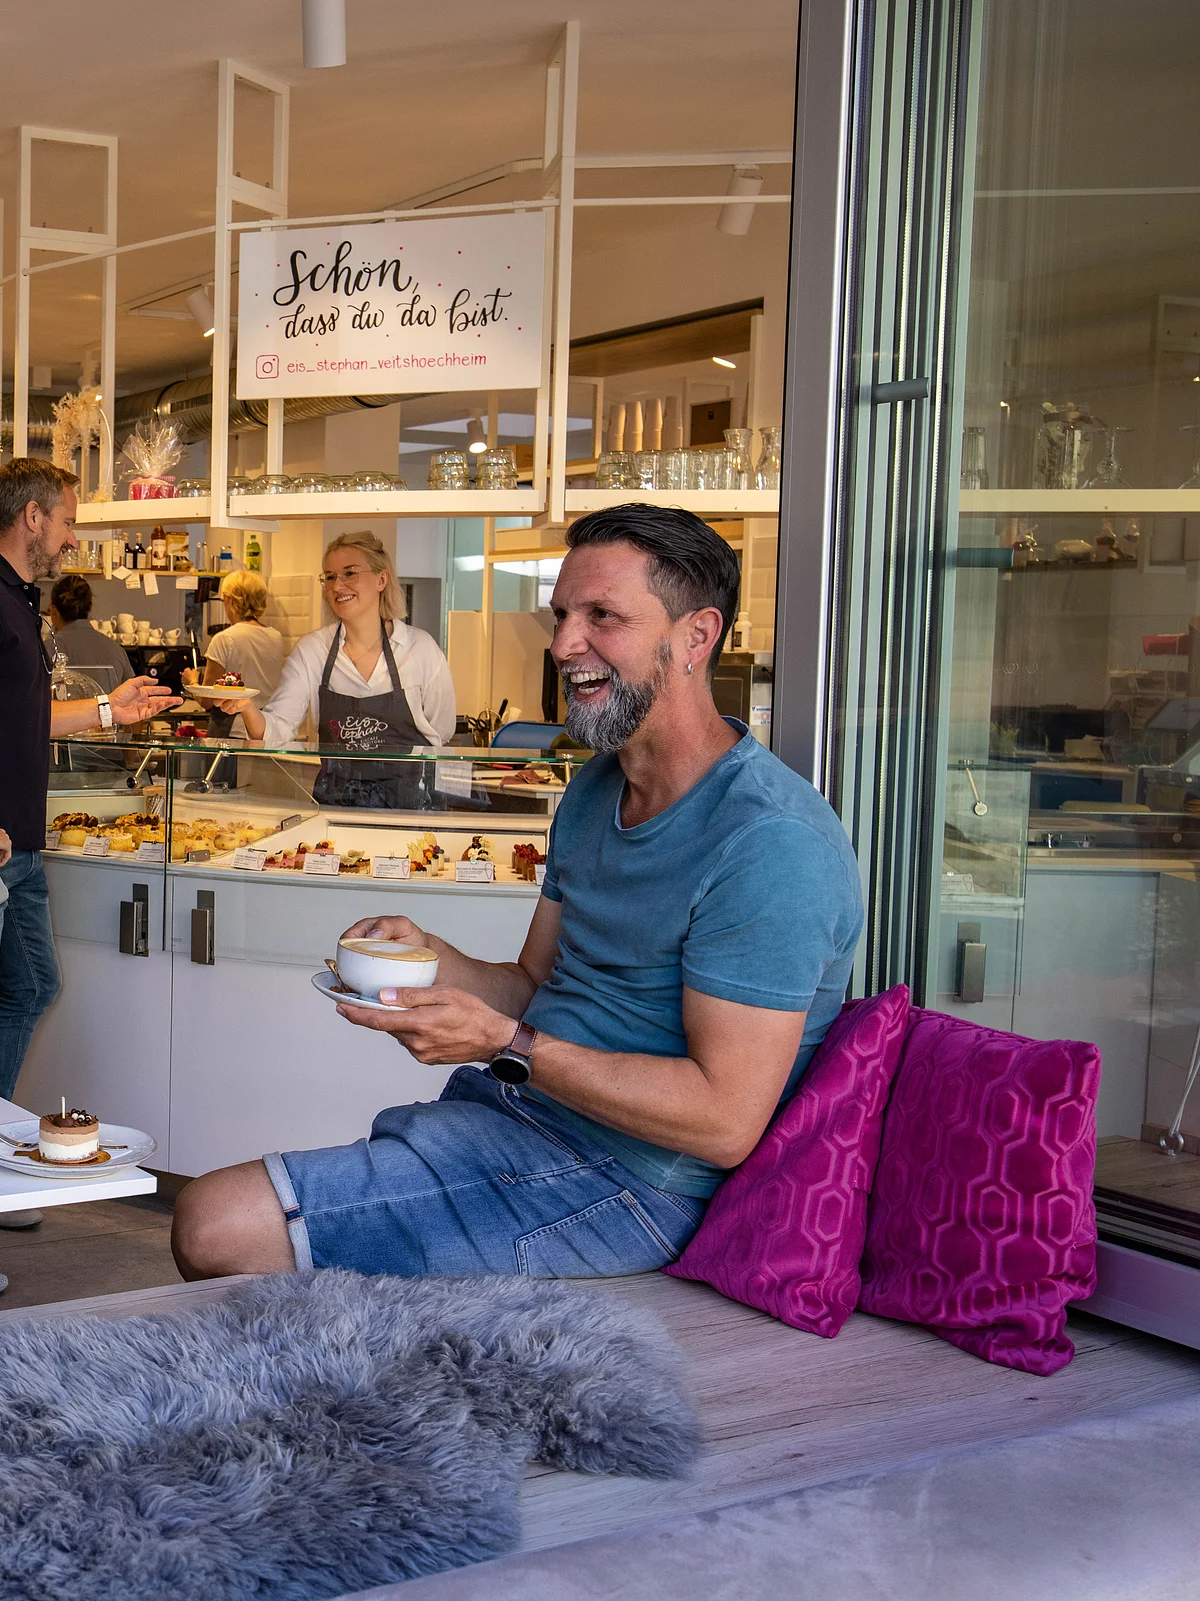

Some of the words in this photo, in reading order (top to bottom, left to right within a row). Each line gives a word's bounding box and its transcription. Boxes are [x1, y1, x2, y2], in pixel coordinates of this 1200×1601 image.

[272, 240, 420, 306] Schön,
[278, 303, 341, 339] dass
[347, 300, 385, 331] du
[396, 294, 437, 327] da
[445, 288, 513, 334] bist.
[286, 351, 488, 375] eis_stephan_veitshoechheim
